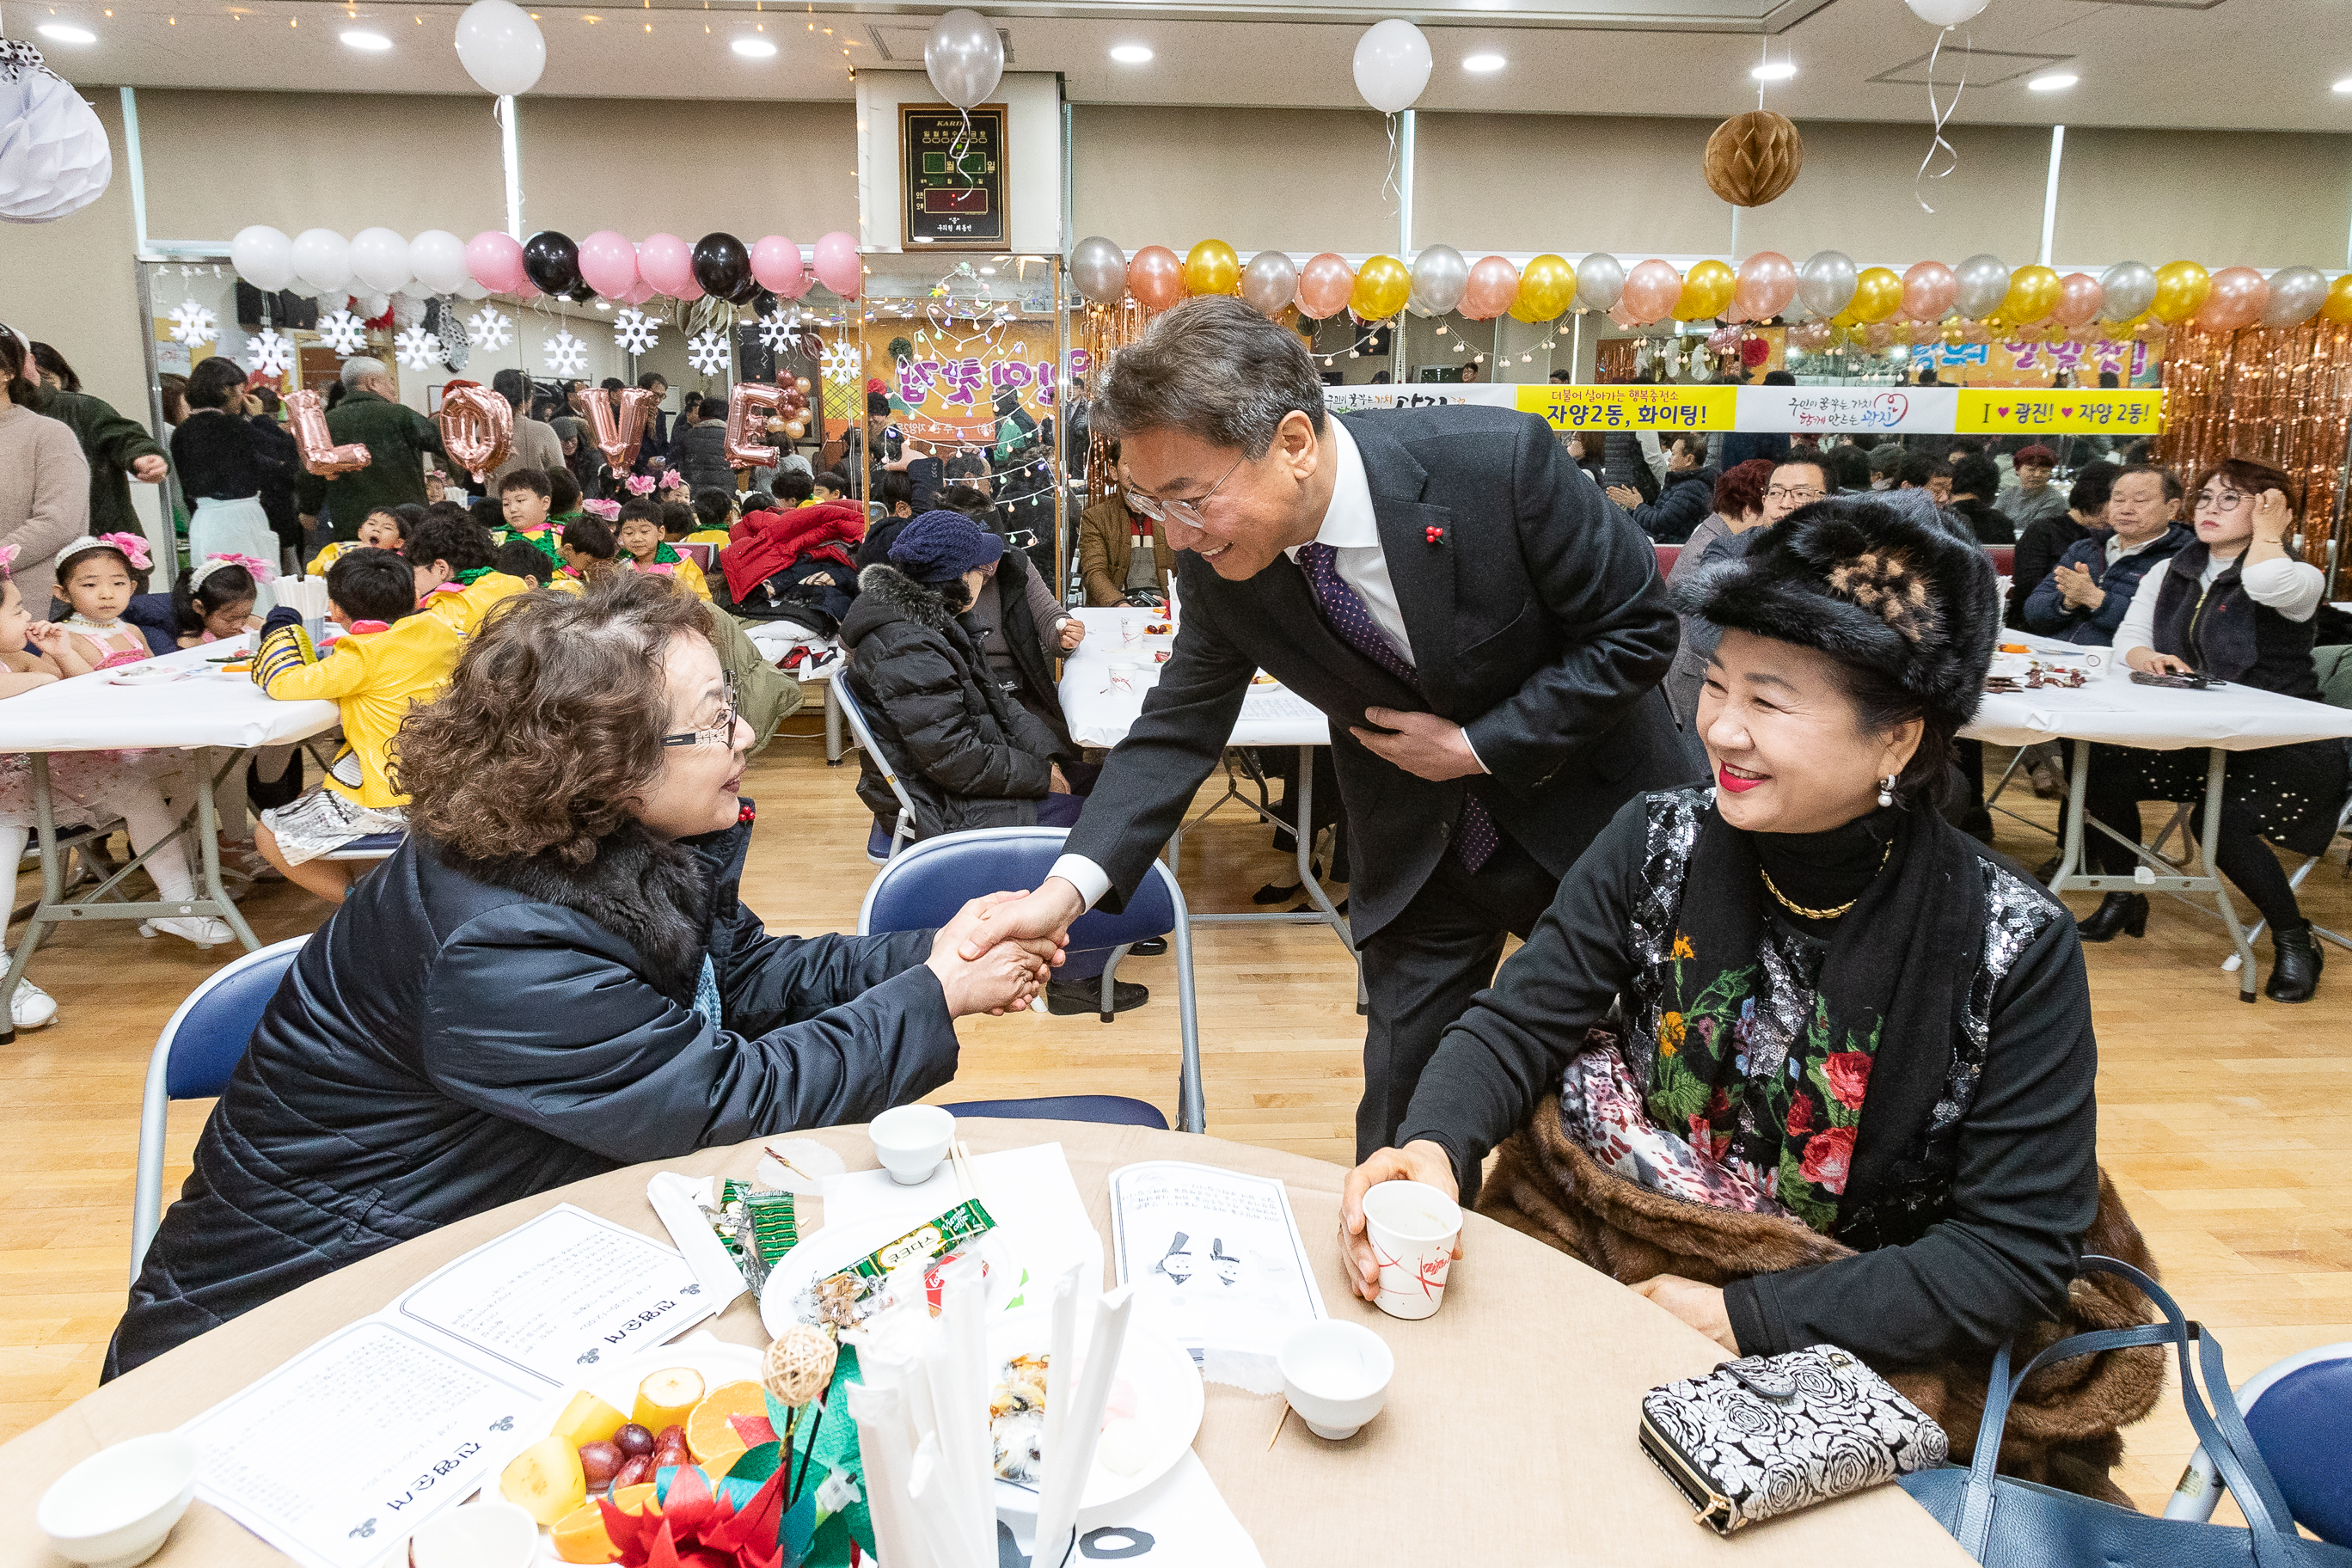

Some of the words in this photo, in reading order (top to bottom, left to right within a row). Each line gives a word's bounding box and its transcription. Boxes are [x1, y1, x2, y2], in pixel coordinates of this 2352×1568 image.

[1552, 389, 1582, 402] 더불어
[1585, 389, 1625, 402] 살아가는
[1629, 389, 1679, 402] 행복충전소
[1820, 396, 1850, 412] 꿈꾸는
[1852, 400, 1871, 409] 가치
[1547, 404, 1630, 427] 자양2동,
[1638, 404, 1706, 426] 화이팅!
[1800, 413, 1826, 426] 함께
[1828, 413, 1860, 426] 만드는
[1982, 403, 1991, 423] I
[2015, 402, 2054, 424] 광진!
[2079, 402, 2112, 424] 자양
[2116, 403, 2150, 425] 2동!
[888, 1236, 935, 1264] 쿠크다스
[604, 1301, 677, 1344] 진행순서
[387, 1442, 481, 1510] 진행순서
